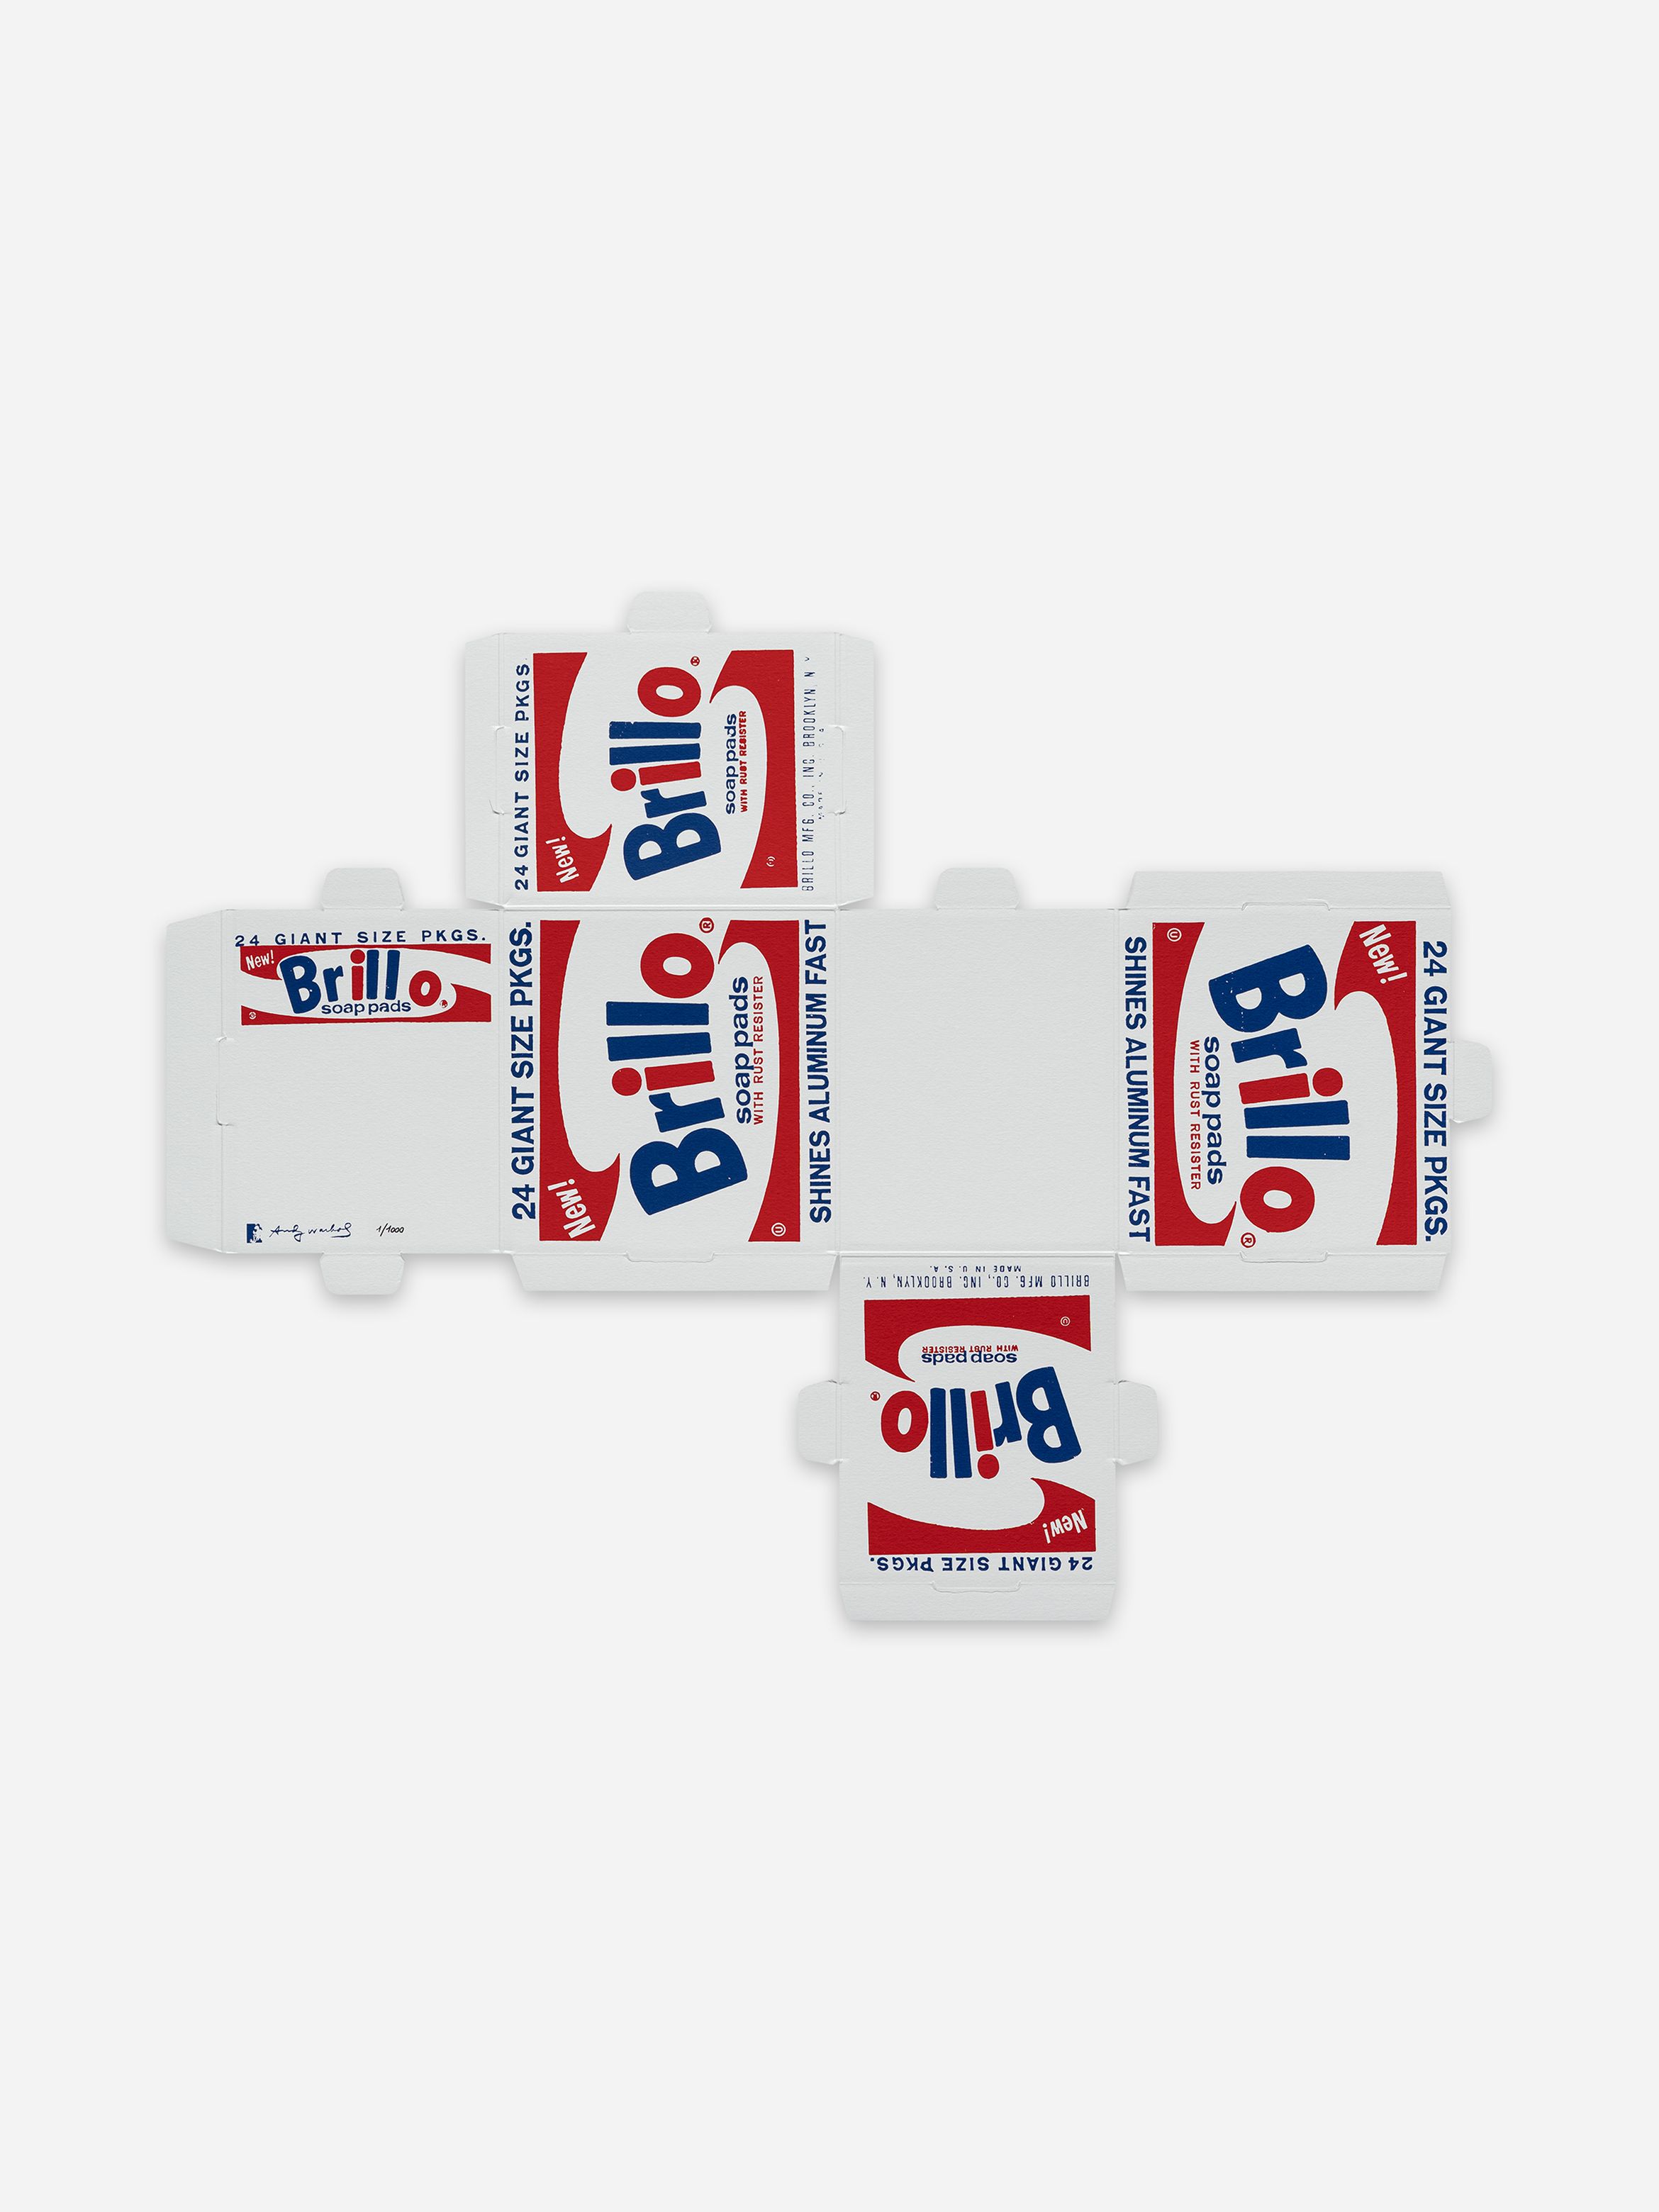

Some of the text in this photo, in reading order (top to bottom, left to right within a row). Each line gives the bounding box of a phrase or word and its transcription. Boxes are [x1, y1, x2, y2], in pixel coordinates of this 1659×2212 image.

[515, 732, 529, 782] SIZE
[609, 666, 722, 881] Brillo
[725, 714, 738, 814] soap pads
[514, 792, 529, 857] GIANT
[515, 865, 528, 890] 24
[545, 836, 579, 883] New!
[802, 851, 813, 890] BRILLO
[235, 929, 485, 946] 24 GIANT SIZE PKGS.
[245, 949, 274, 970] New!
[1359, 924, 1407, 984] New!
[279, 949, 441, 1014] Brillo
[321, 1000, 411, 1016] soap pads
[510, 922, 535, 1219] 24 GIANT SIZE PKGS.
[606, 932, 748, 1215] Brillo
[729, 976, 754, 1124] soap pads
[753, 977, 763, 1124] WITH RUST RESISTER
[805, 920, 831, 1222] SHINES ALUMINUM FAST
[1125, 937, 1150, 1241] SHINES ALUMINUM FAST
[1191, 1041, 1200, 1188] WITH RUST RESISTER
[1202, 1037, 1227, 1184] soap pads
[1209, 944, 1350, 1233] Brillo
[1424, 942, 1448, 1241] 24 GIANT SIZE PKGS.
[376, 1224, 404, 1236] 1/1000
[547, 1178, 596, 1239] New!
[894, 1276, 951, 1287] BROOKLYN,
[960, 1276, 981, 1287] INC.
[1017, 1275, 1042, 1287] MFG.
[1051, 1275, 1089, 1287] BRILLO
[922, 1351, 1017, 1365] soap pads
[881, 1366, 1081, 1479] Brillo
[1043, 1509, 1088, 1543] New!
[871, 1557, 1093, 1572] 24 GIANT SIZE PKGS.
